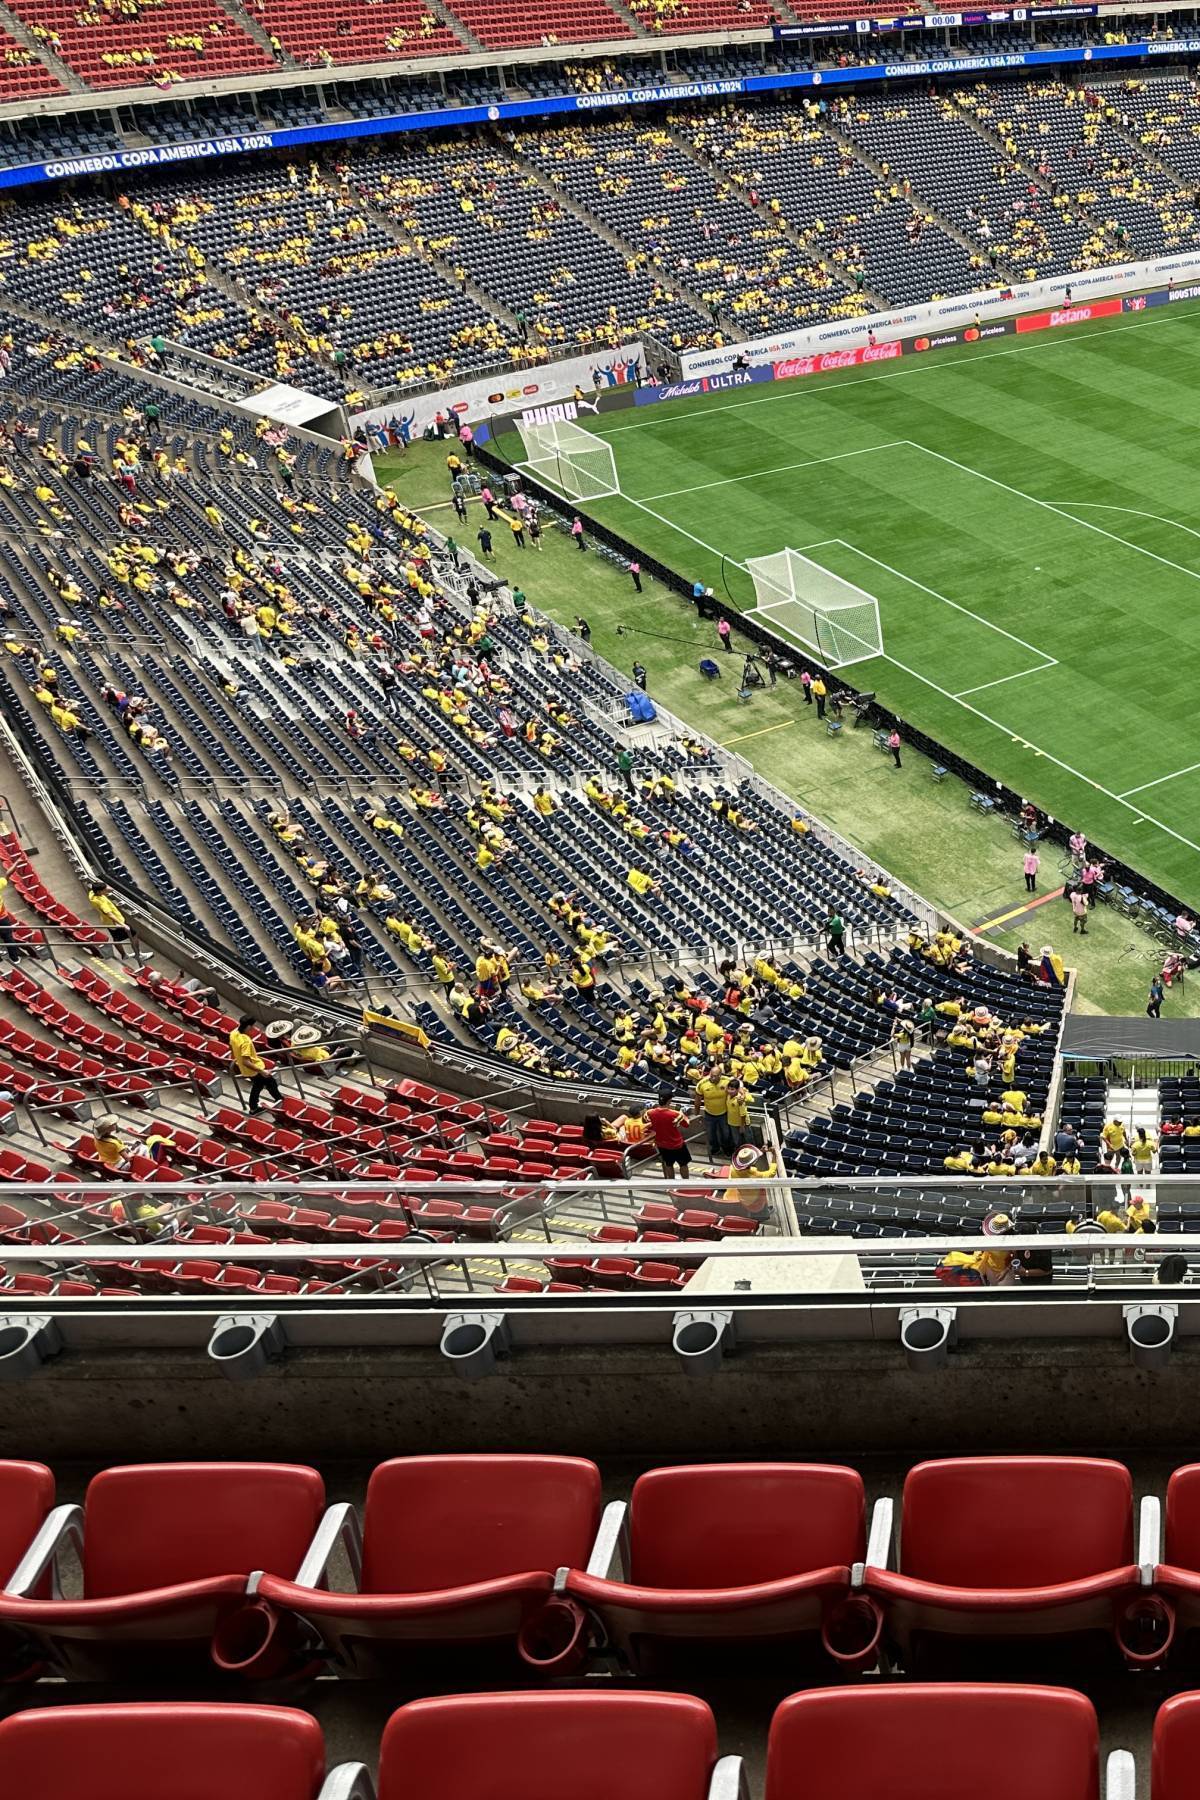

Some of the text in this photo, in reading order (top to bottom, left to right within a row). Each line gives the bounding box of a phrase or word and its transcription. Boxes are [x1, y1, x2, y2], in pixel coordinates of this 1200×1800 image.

[1148, 42, 1189, 54] CONMEBOL
[885, 55, 1025, 76] CONMEBOL COPA AMERICA USA 2024
[576, 82, 741, 108] CONMEBOL COPA AMERICA USA 2024
[45, 134, 273, 178] CONMEBOL COPA AMERICA USA 2024
[1092, 274, 1114, 284] AMERICA
[938, 304, 969, 315] CONMEBOL
[969, 300, 983, 309] COPA
[1050, 308, 1091, 326] Betano
[818, 329, 851, 341] CONMEBOL
[851, 325, 867, 334] COPA
[867, 320, 892, 331] AMERICA
[903, 315, 917, 324] 2024
[980, 325, 1005, 337] priceless
[931, 334, 957, 346] priceless
[688, 357, 723, 370] CONMEBOL
[724, 353, 739, 362] COP
[769, 344, 781, 353] USA
[781, 341, 796, 351] 2024
[658, 372, 752, 400] Michelob ULTRA
[522, 402, 578, 428] PUMA
